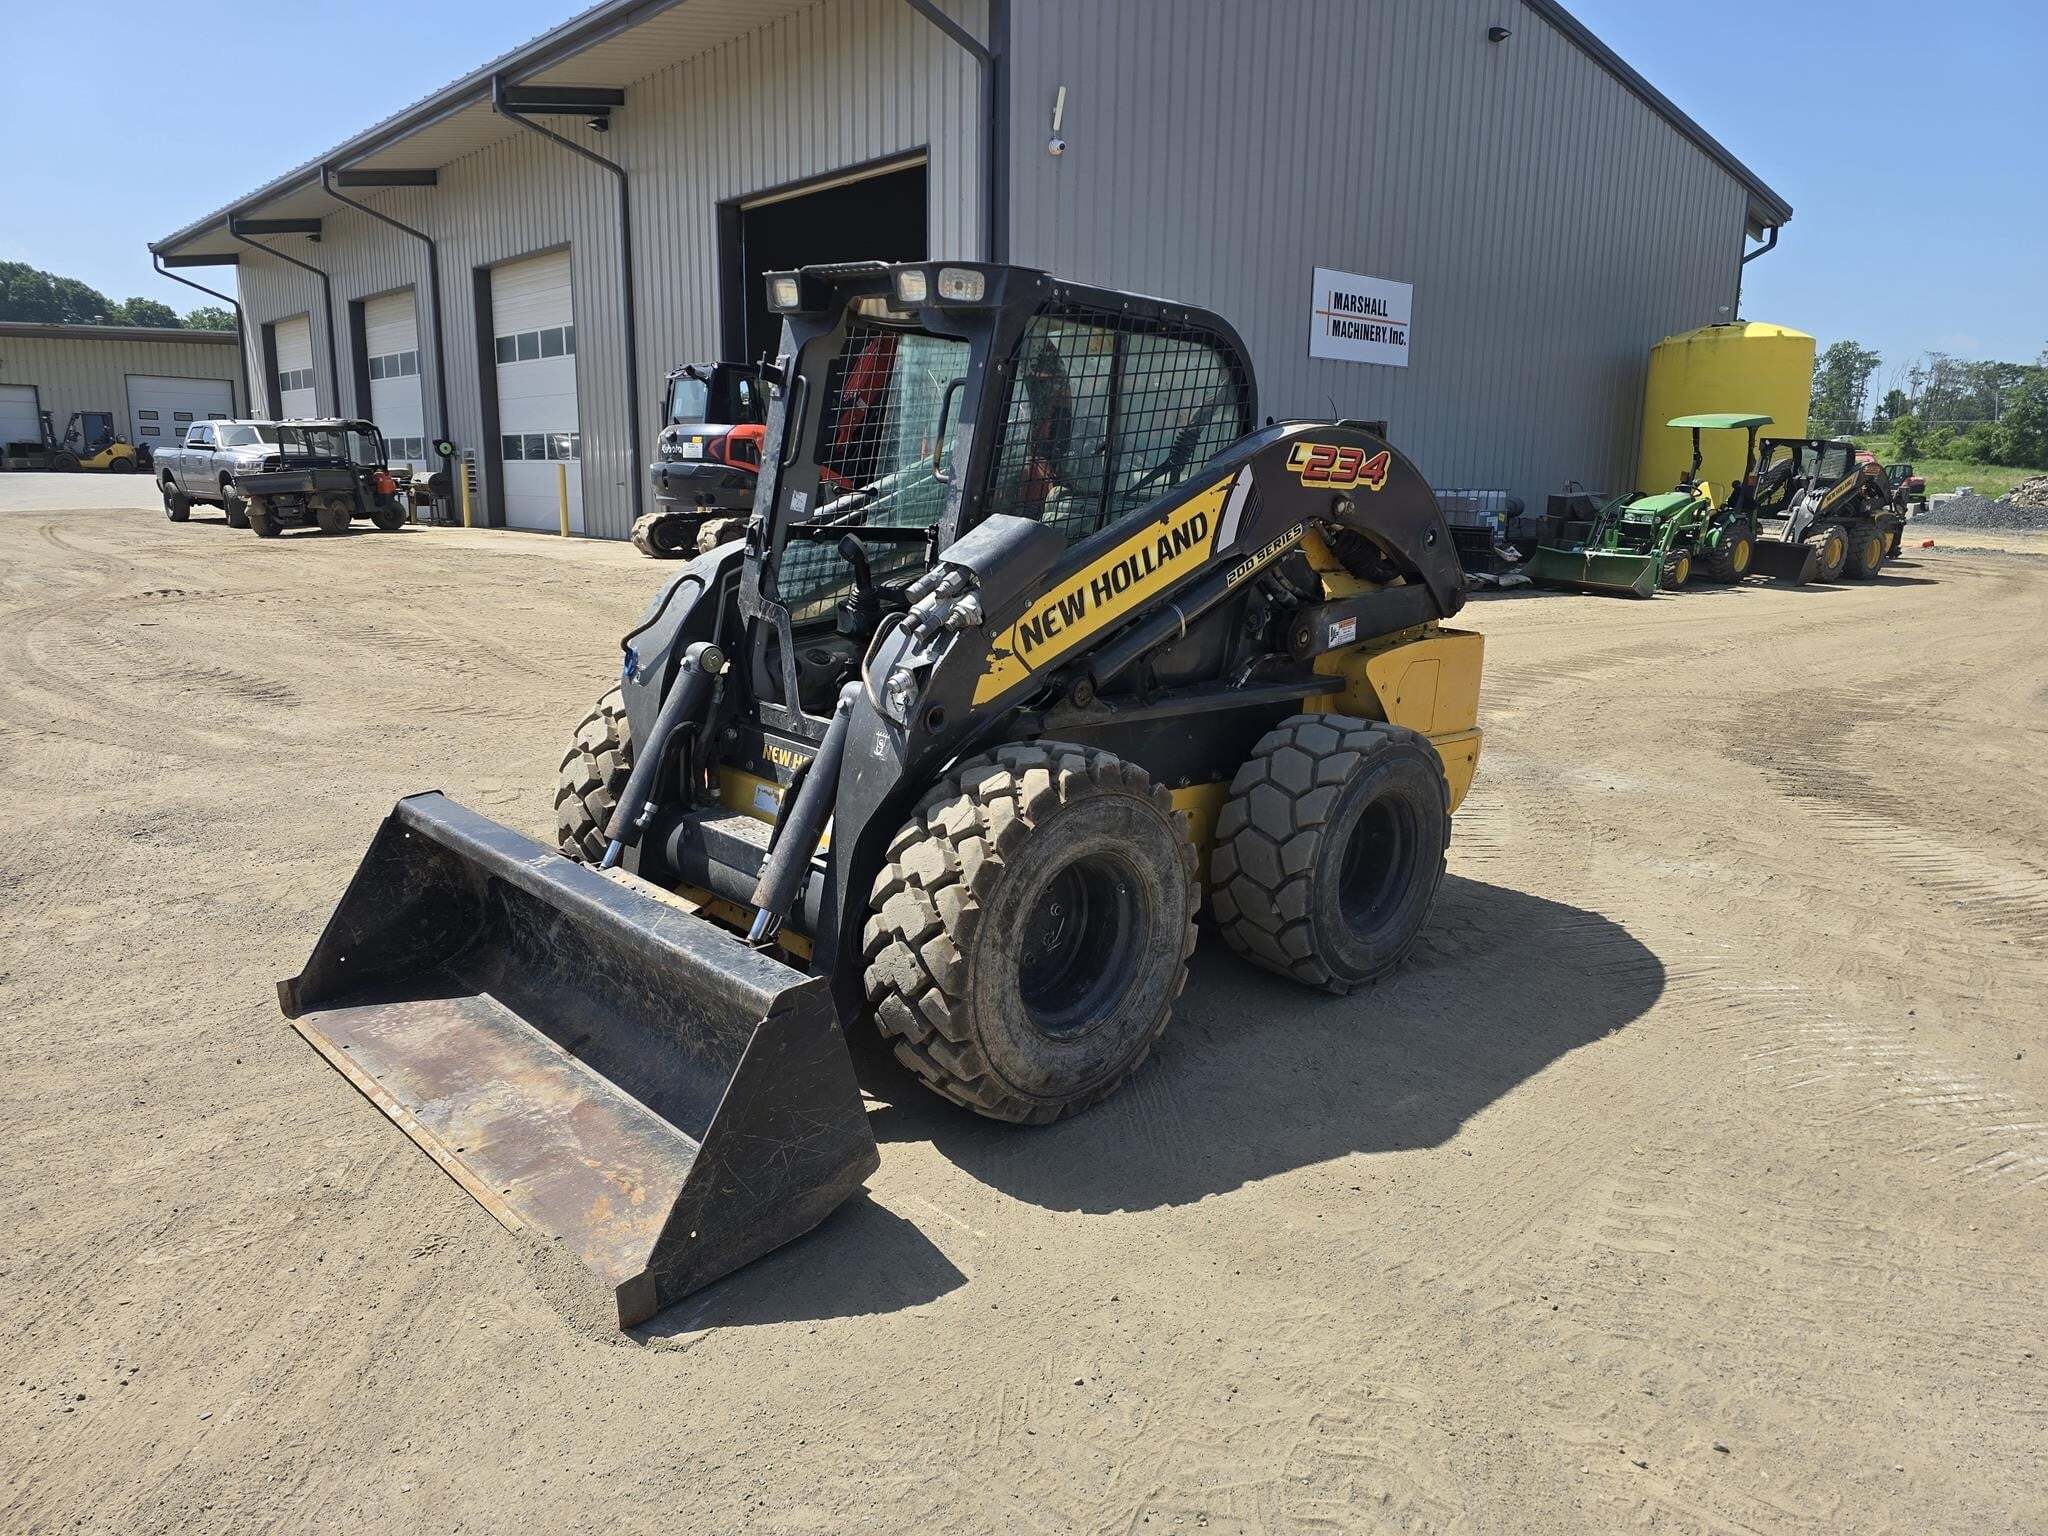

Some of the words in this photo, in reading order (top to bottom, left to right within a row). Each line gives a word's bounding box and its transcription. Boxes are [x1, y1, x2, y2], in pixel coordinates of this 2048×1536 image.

[1334, 291, 1388, 317] MARSHALL
[1389, 326, 1406, 346] Inc.
[1288, 444, 1390, 488] L234
[1228, 561, 1255, 585] 200
[1256, 524, 1303, 563] SERIES
[1019, 588, 1085, 654] NEW
[1090, 511, 1208, 608] HOLLAND
[763, 744, 792, 767] NEW
